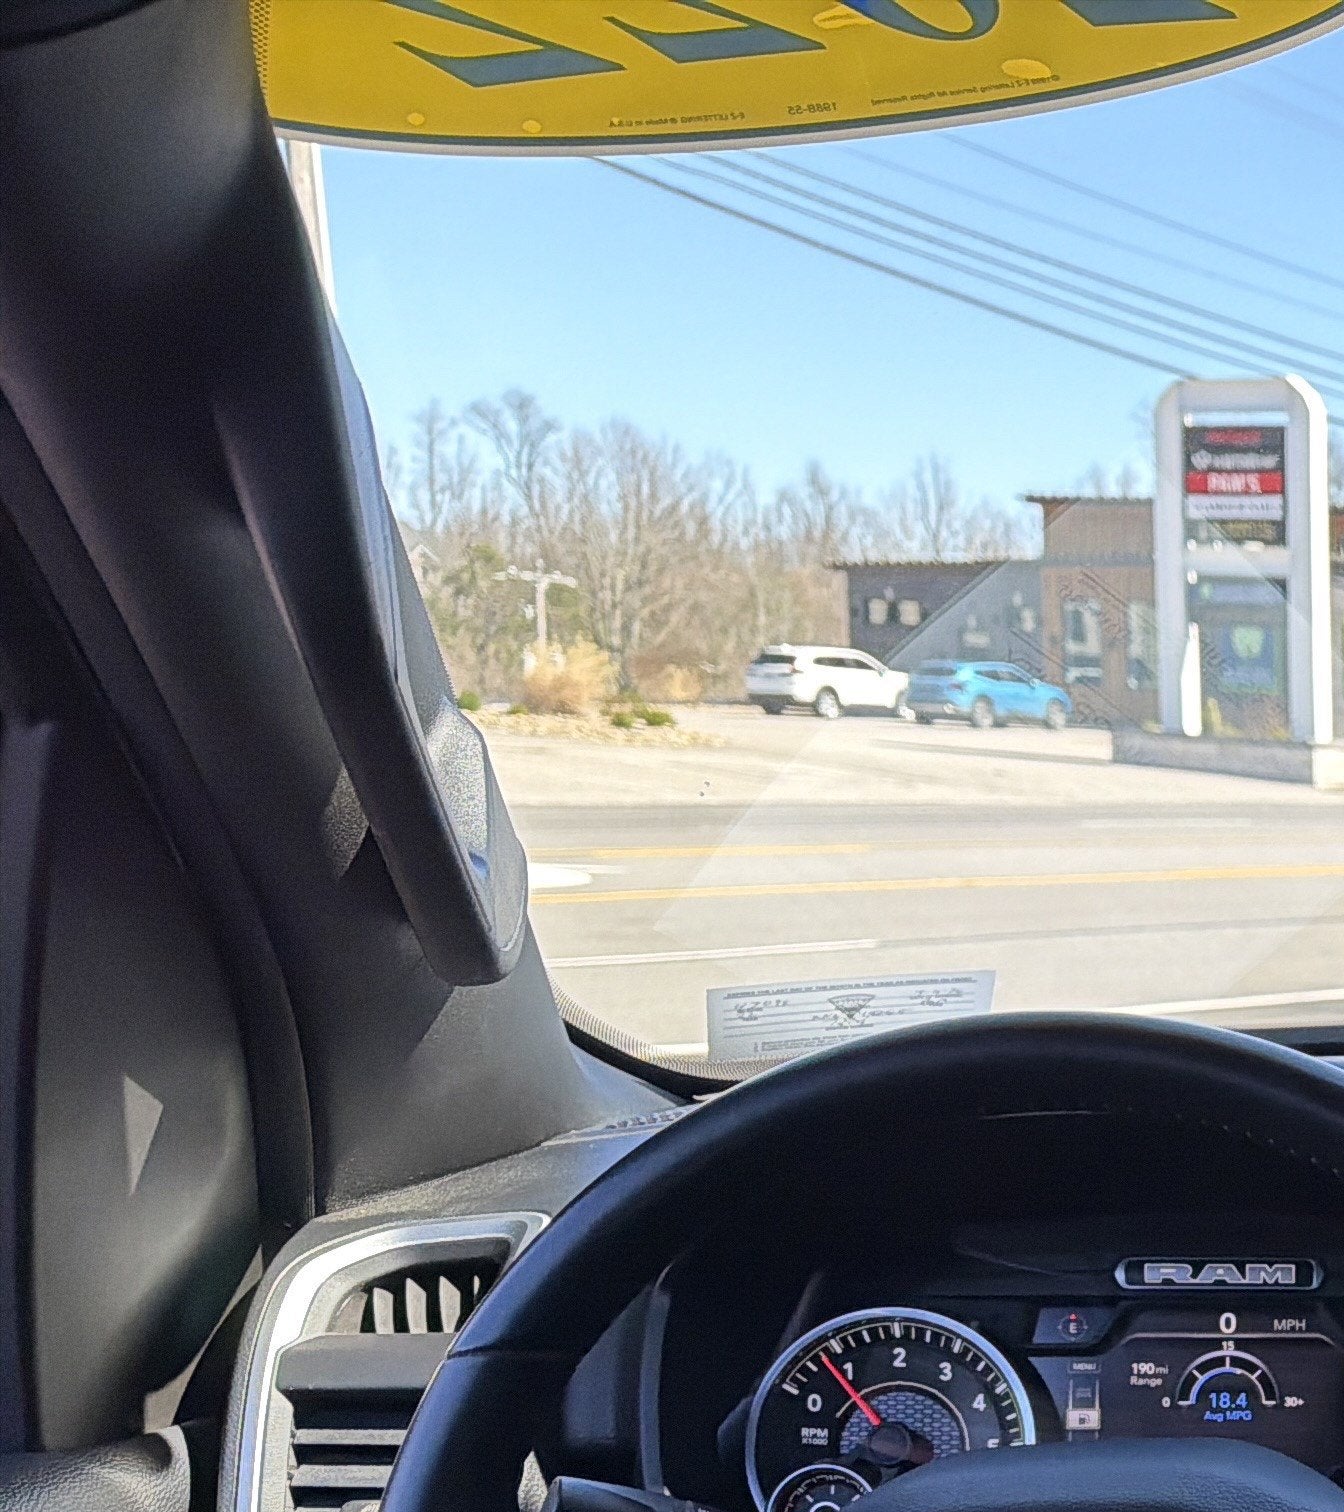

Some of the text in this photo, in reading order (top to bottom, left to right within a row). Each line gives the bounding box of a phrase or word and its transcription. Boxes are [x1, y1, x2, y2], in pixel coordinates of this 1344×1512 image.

[1144, 1263, 1296, 1284] RAM
[1069, 1322, 1077, 1334] E
[1219, 1313, 1236, 1334] 0
[1273, 1319, 1306, 1332] MPH
[1221, 1341, 1235, 1351] 15
[892, 1347, 907, 1369] 2
[842, 1362, 854, 1381] 1
[938, 1361, 953, 1382] 3
[1130, 1376, 1163, 1388] Range
[807, 1394, 822, 1413] 0
[972, 1393, 987, 1412] 4
[1162, 1397, 1170, 1408] 0
[1208, 1393, 1248, 1410] 18.4
[801, 1427, 829, 1439] RPM
